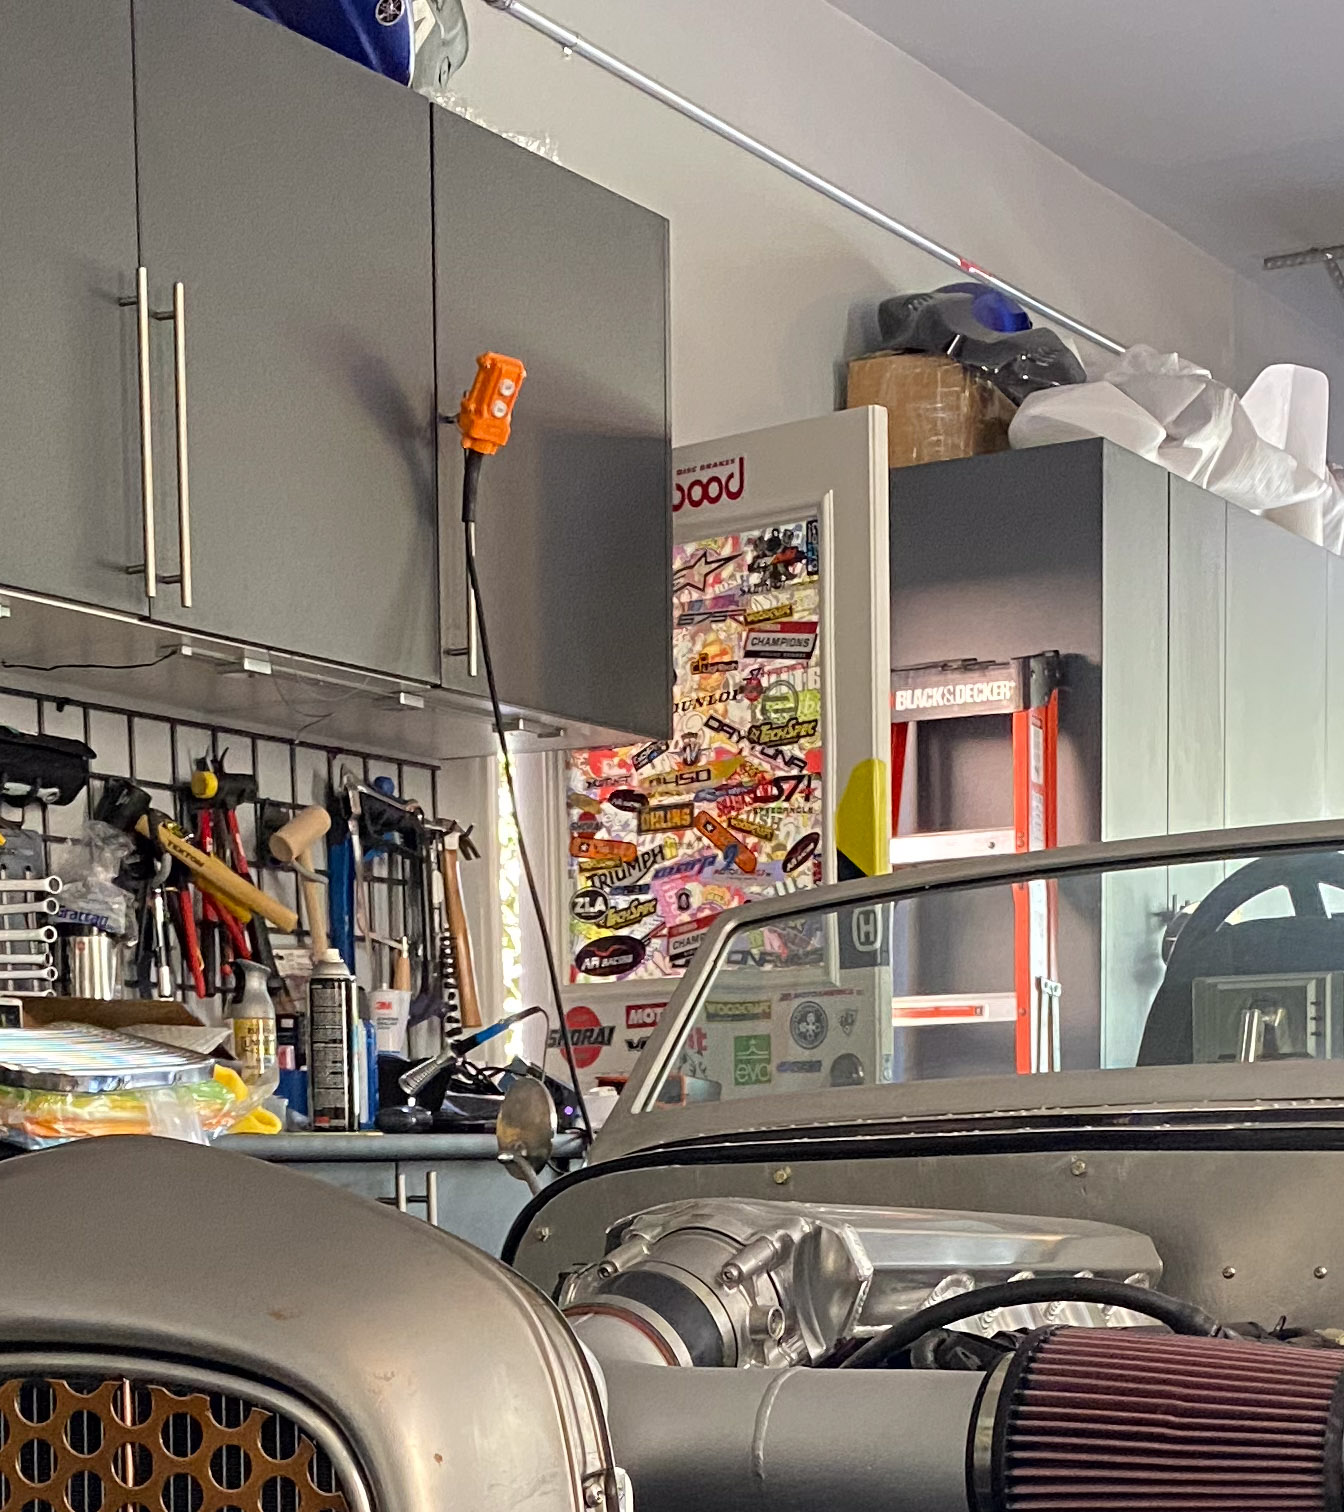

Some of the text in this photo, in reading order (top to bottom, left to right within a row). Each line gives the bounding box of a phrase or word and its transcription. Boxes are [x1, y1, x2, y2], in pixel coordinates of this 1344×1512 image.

[676, 458, 736, 476] DISC BRAKES
[751, 634, 810, 648] CHAMPIONS
[895, 680, 1011, 711] BLACK&DECKER
[704, 714, 808, 774] DAYONA
[585, 843, 665, 889] TRIUMPH
[573, 896, 607, 913] ZLA
[375, 1001, 393, 1011] 3M
